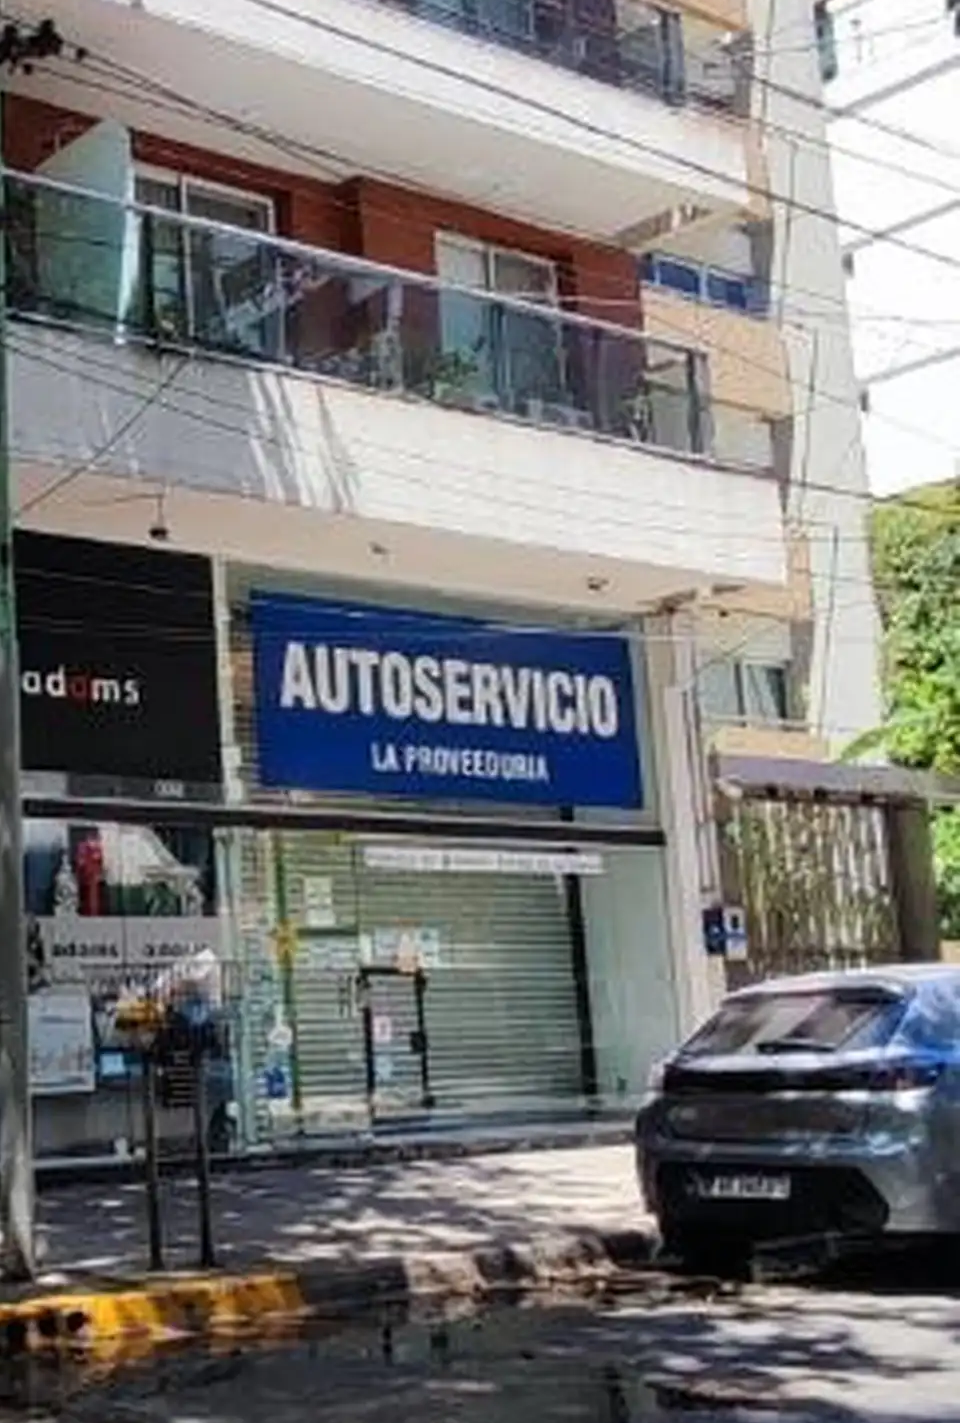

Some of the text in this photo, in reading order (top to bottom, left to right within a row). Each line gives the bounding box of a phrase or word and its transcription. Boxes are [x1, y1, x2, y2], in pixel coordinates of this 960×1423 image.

[21, 664, 140, 706] adams
[280, 640, 619, 738] AUTOSERVICIO
[371, 741, 549, 781] LA PROVEEDURIA
